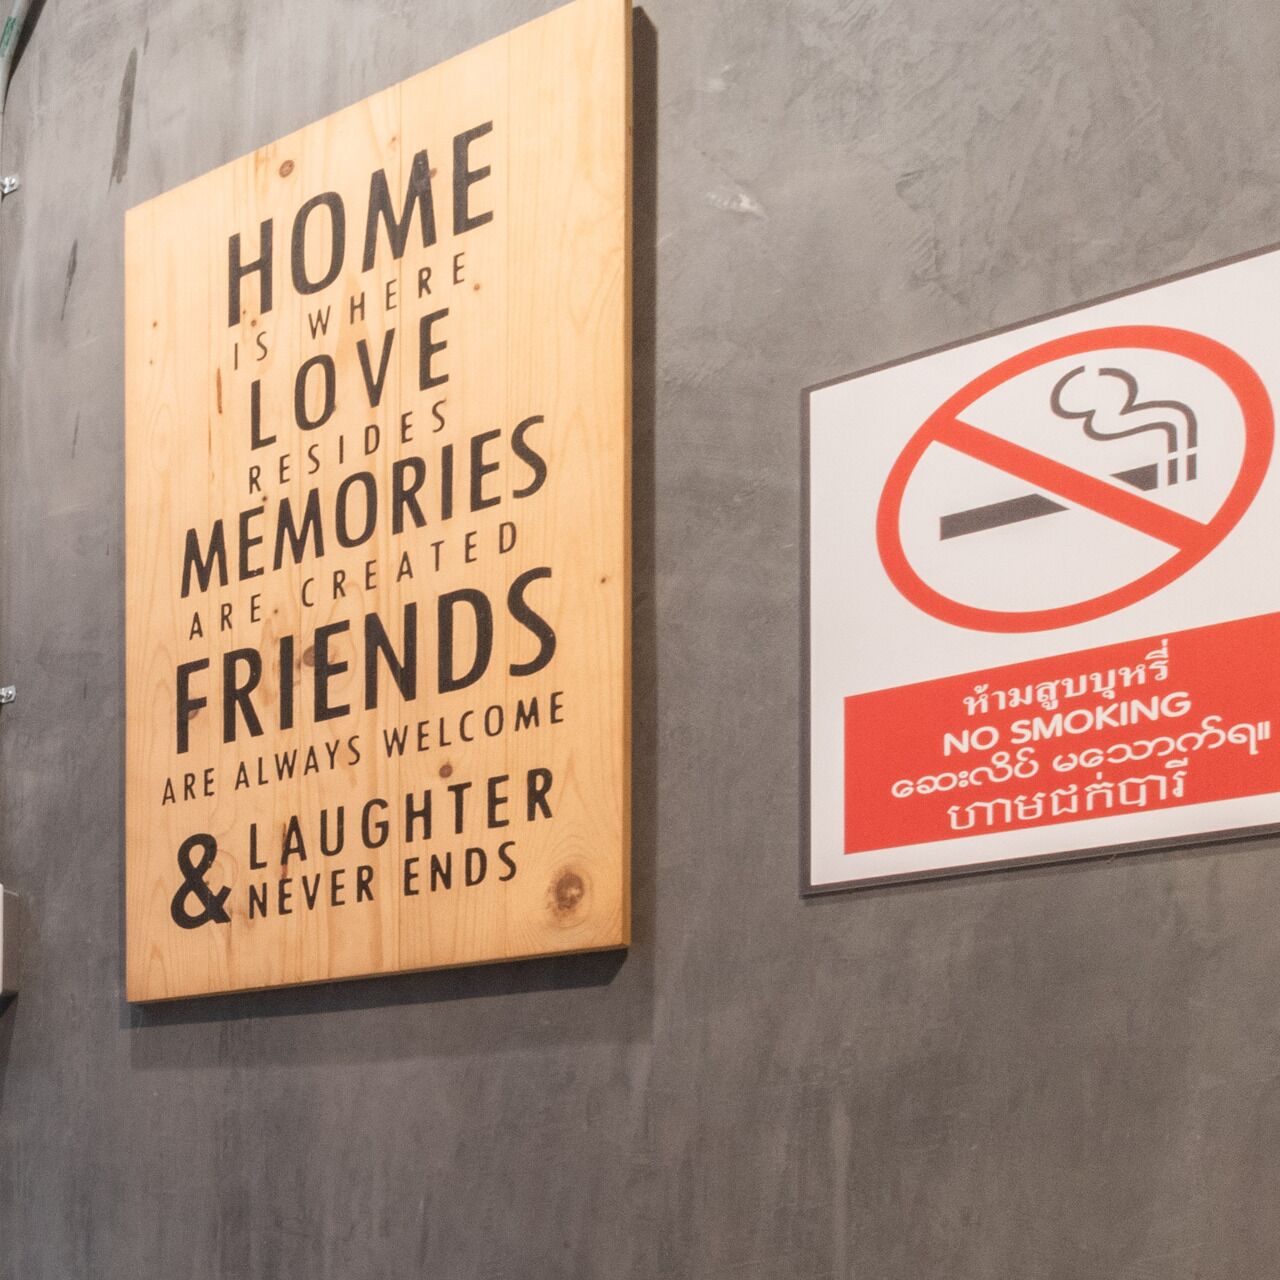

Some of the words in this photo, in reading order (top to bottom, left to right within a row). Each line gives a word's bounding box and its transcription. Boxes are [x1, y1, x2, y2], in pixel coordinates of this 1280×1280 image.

[228, 120, 493, 328] HOME
[234, 331, 268, 371] IS
[308, 252, 466, 339] WHERE
[250, 307, 450, 450] LOVE
[180, 415, 548, 598] MEMORIES
[248, 400, 446, 494] RESIDES
[188, 593, 262, 641] ARE
[301, 521, 518, 608] CREATED
[176, 567, 557, 755] FRIENDS
[962, 638, 1169, 716] ห้ามสูบบุหรี่
[161, 767, 216, 806] ARE
[235, 735, 361, 791] ALWAYS
[383, 691, 565, 758] WELCOME
[943, 725, 1000, 757] NO
[1010, 691, 1192, 745] SMOKING
[170, 833, 232, 930] &
[249, 767, 554, 870] LAUGHTER
[248, 865, 375, 920] NEVER
[404, 841, 518, 896] ENDS
